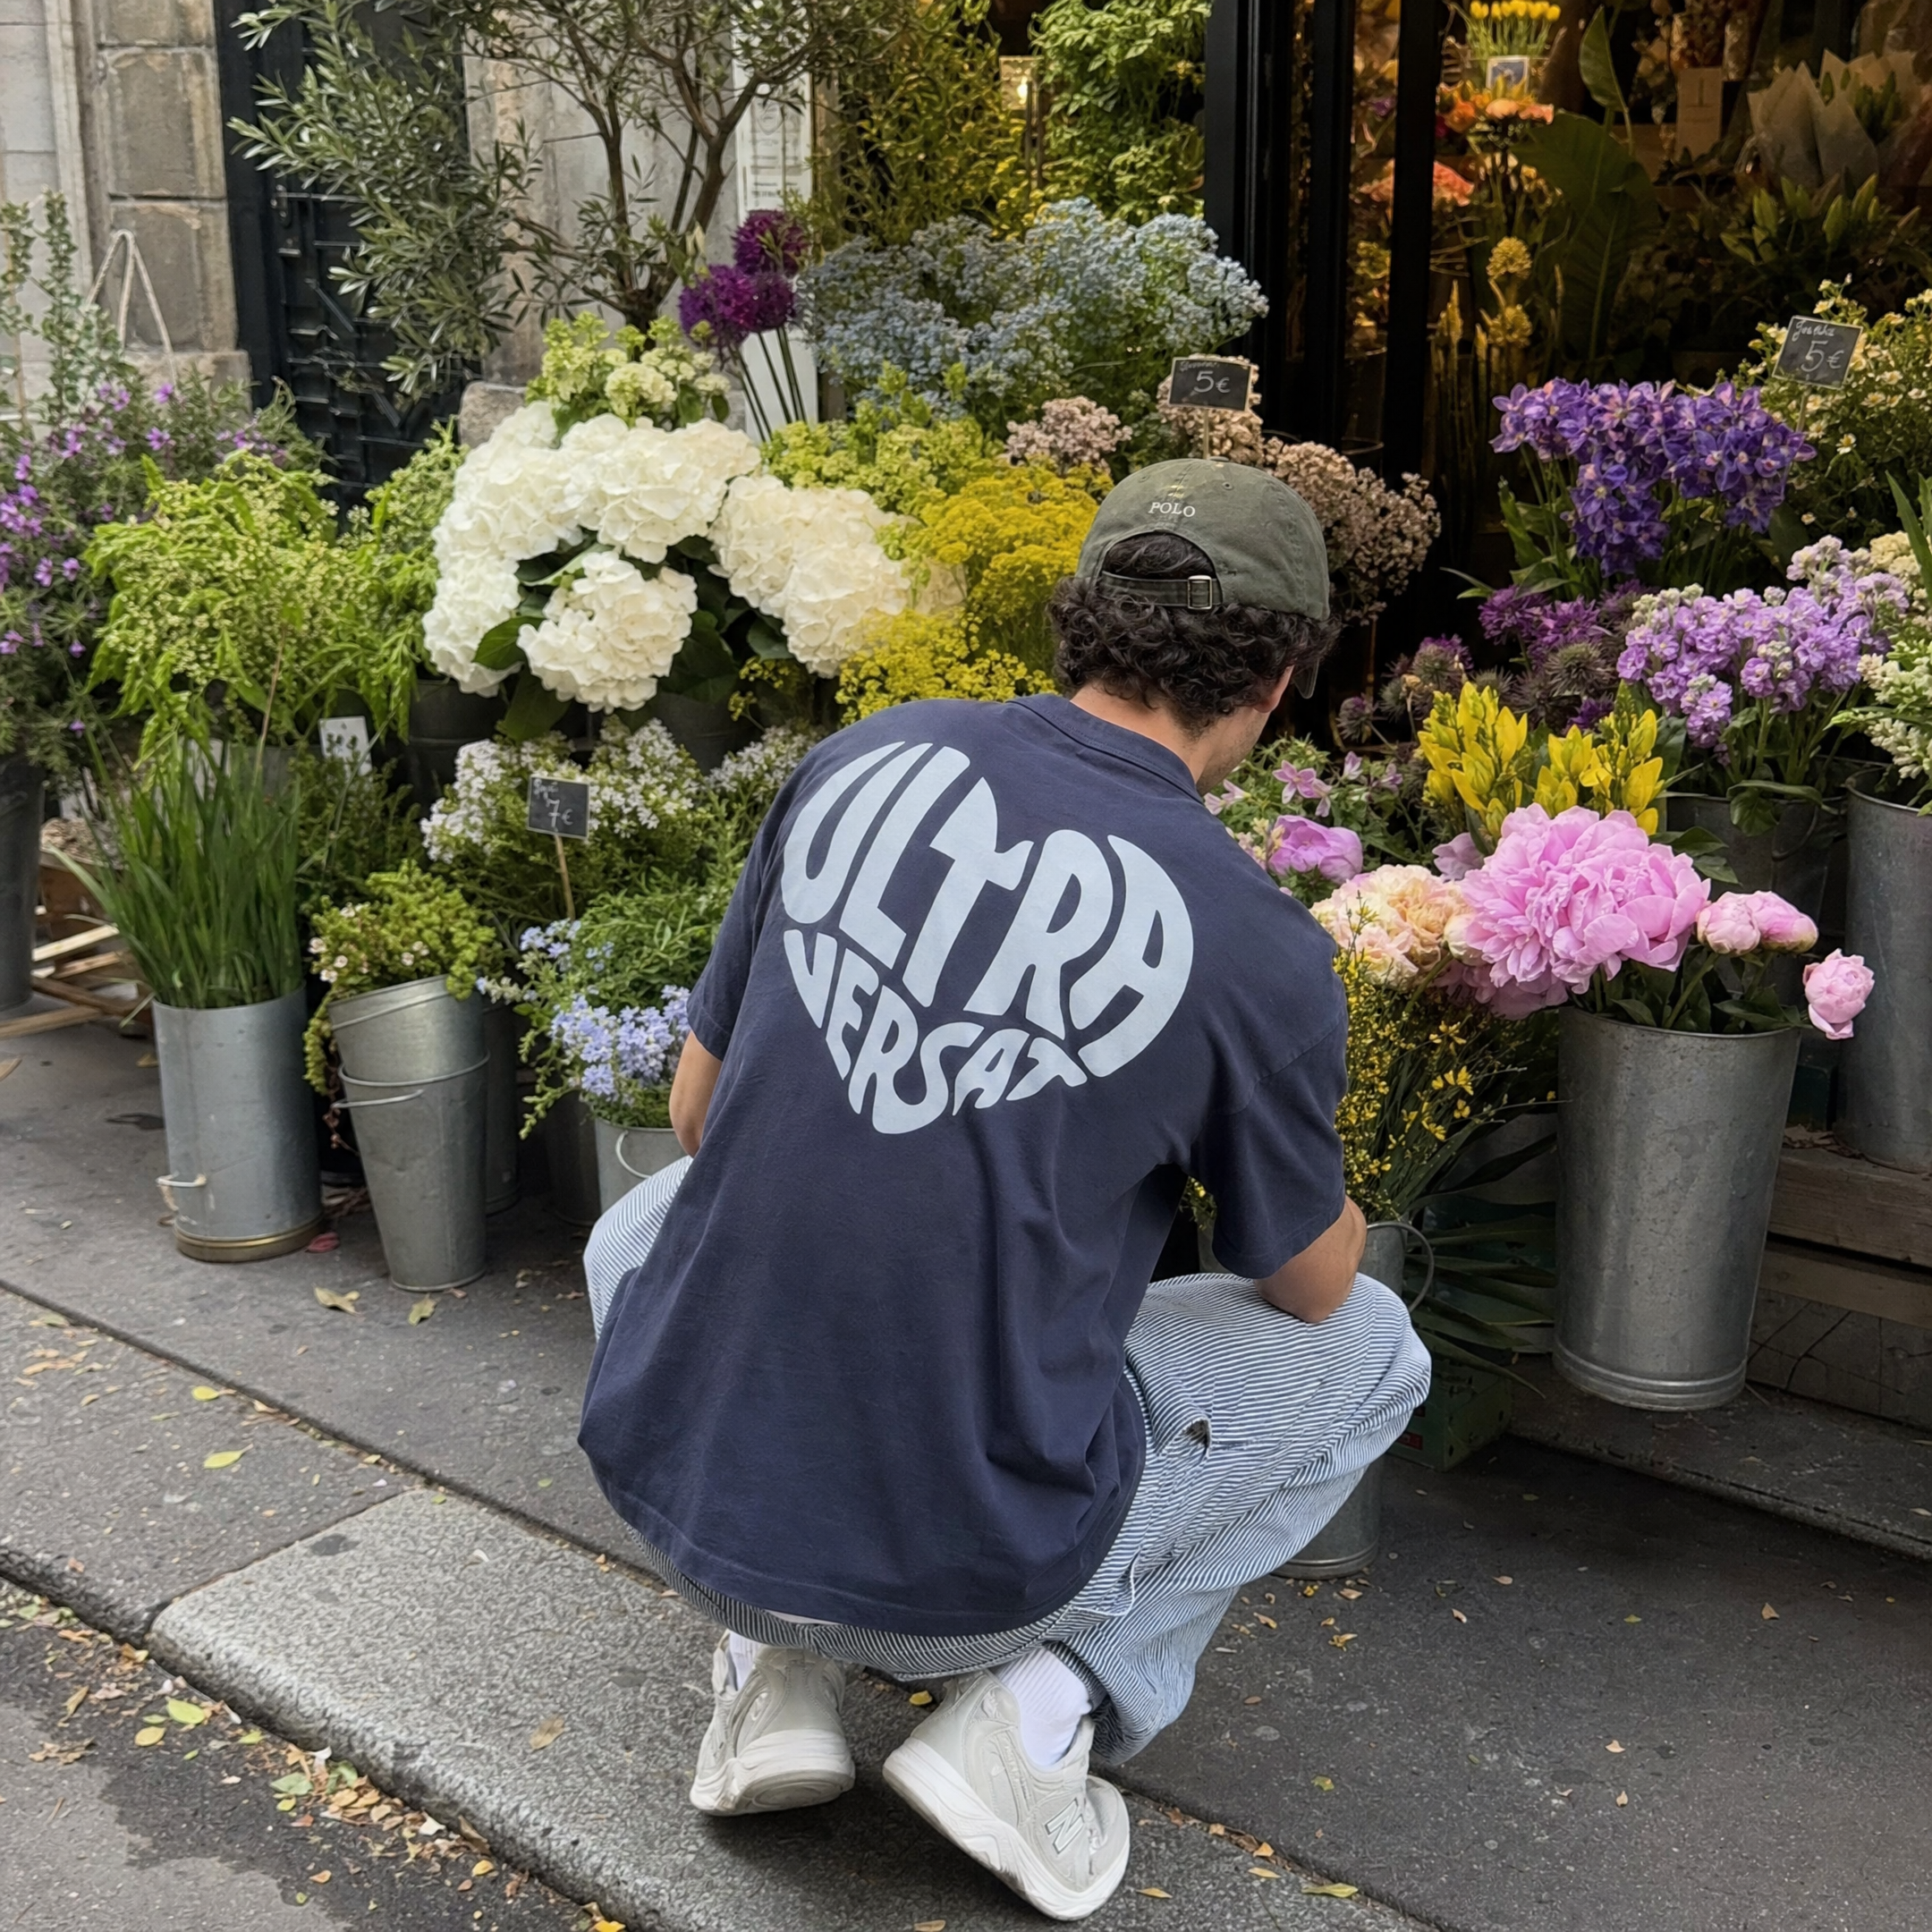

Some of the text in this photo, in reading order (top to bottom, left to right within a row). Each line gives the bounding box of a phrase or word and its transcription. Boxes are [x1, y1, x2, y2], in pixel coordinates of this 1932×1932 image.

[1801, 340, 1844, 372] 5€
[1194, 370, 1231, 394] 5€
[1148, 502, 1196, 518] POLO
[546, 800, 573, 827] 7€
[781, 741, 1194, 1078] ULTRA
[784, 929, 1088, 1134] VERSAT
[1045, 1798, 1085, 1855] N
